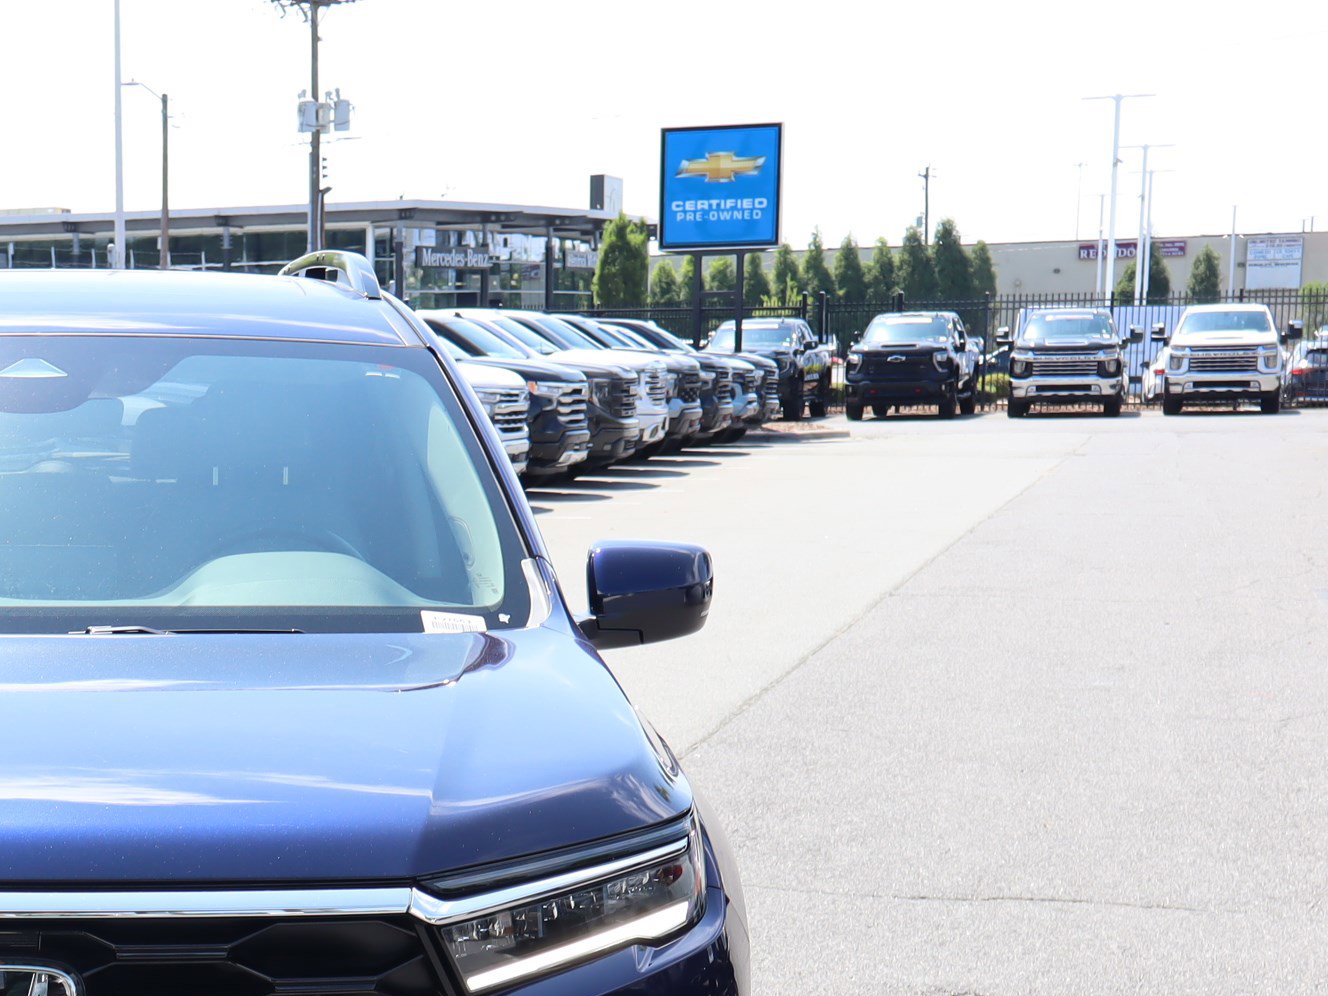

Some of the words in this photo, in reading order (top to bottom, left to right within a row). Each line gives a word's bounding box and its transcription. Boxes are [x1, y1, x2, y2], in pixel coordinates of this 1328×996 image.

[671, 197, 768, 212] CERTIFIED
[676, 209, 762, 222] PRE-OWNED
[422, 247, 489, 267] Mercedes-Benz
